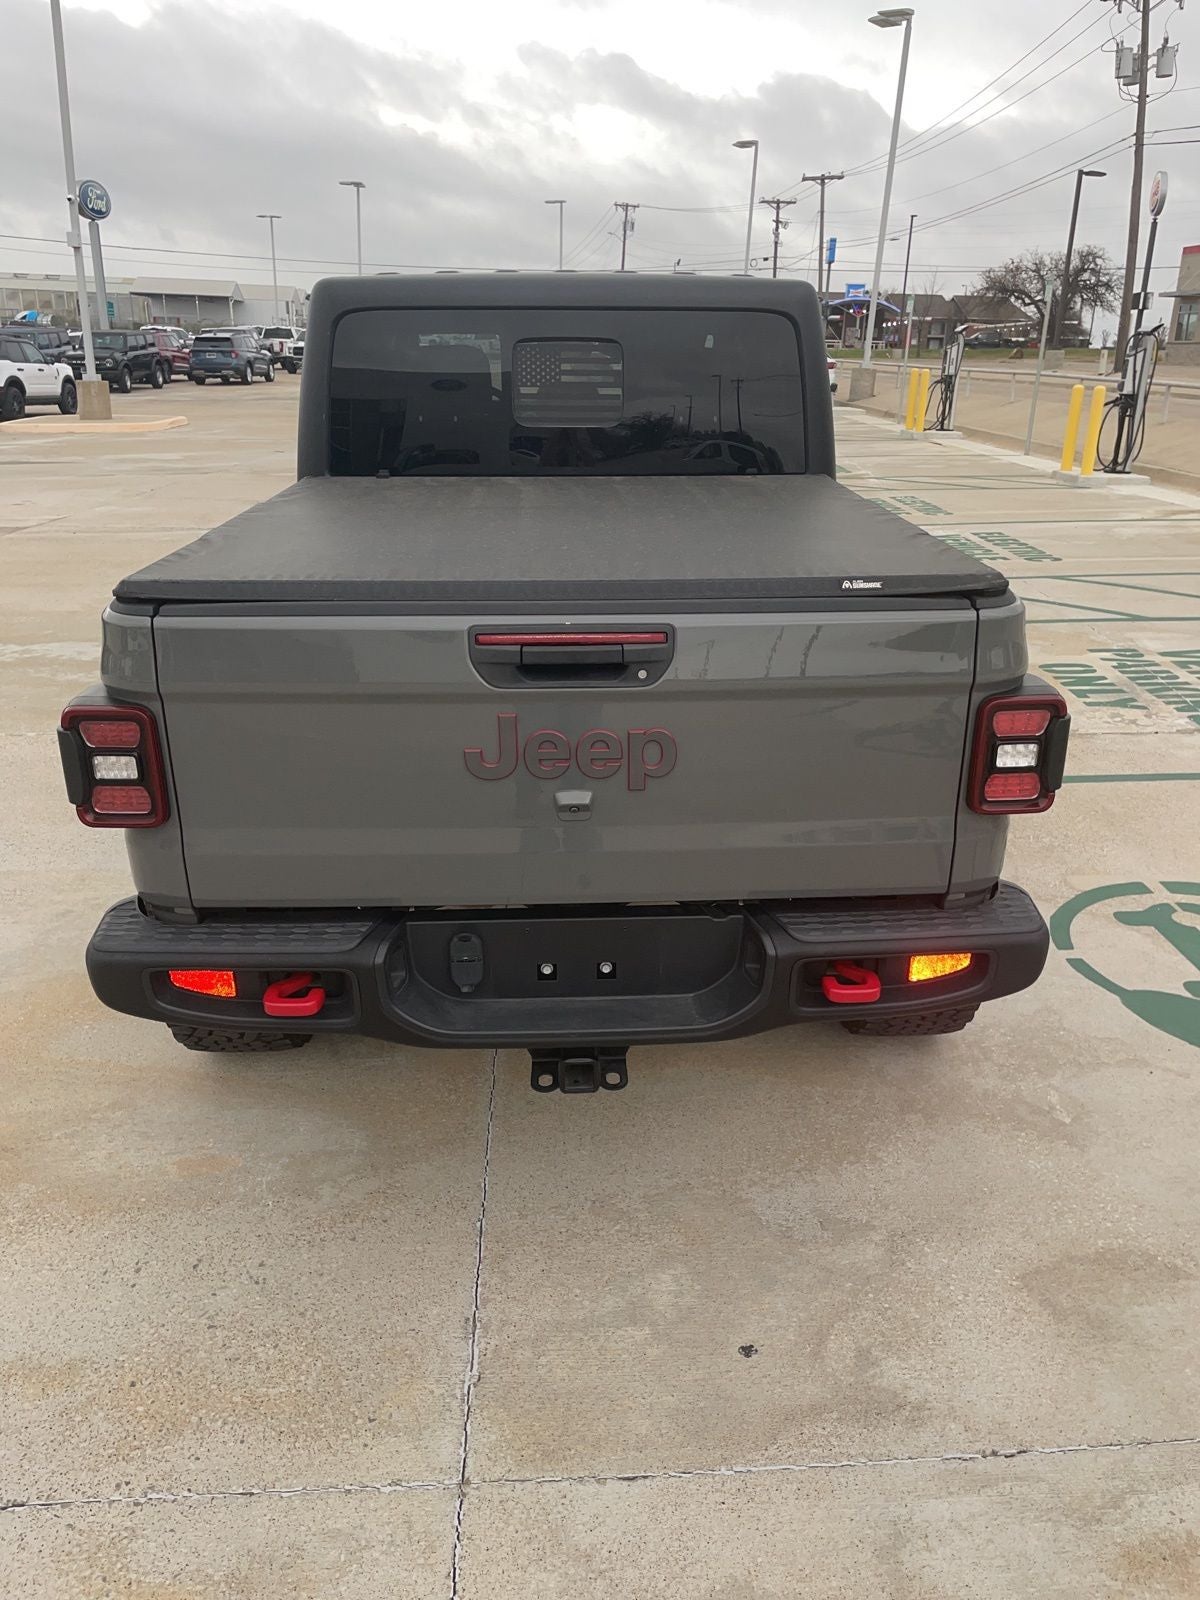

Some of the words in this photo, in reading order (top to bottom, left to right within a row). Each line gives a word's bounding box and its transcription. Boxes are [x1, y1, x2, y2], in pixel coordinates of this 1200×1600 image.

[87, 186, 107, 212] Ford
[970, 531, 1063, 562] ELECTRIC
[1038, 663, 1150, 711] ONLY
[1086, 648, 1200, 726] PARKIN
[463, 712, 678, 791] Jeep
